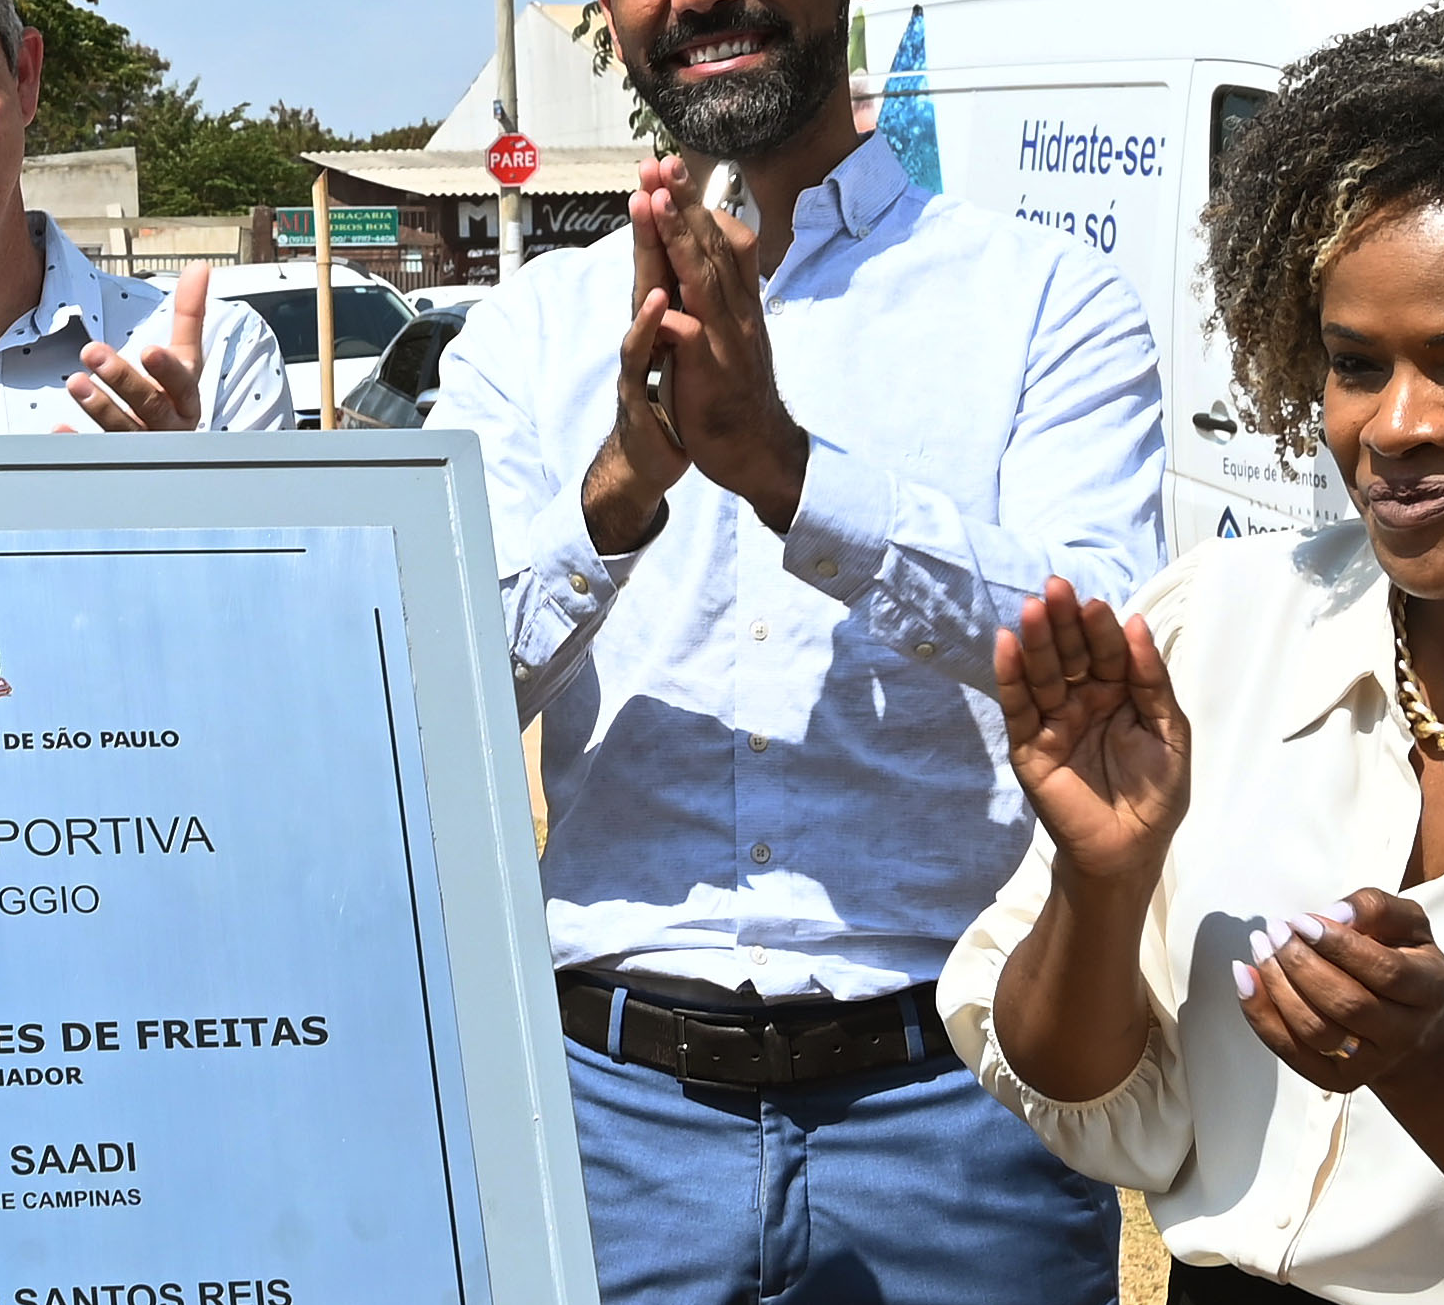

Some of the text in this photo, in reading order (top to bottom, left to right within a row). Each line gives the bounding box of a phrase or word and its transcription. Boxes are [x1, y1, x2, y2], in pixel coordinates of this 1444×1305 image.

[490, 151, 535, 168] PARE
[1019, 119, 1165, 176] Hidrate-se:
[280, 212, 310, 234] MJ
[329, 211, 393, 221] DRAÇARIA
[330, 223, 391, 231] DROS BOX
[1084, 199, 1117, 254] só
[1223, 457, 1328, 489] Equipe de eentos
[3, 732, 34, 751] DE
[42, 727, 92, 751] SÃO
[100, 730, 180, 750] PAULO
[61, 1021, 120, 1052] DE
[136, 1016, 329, 1050] FREITAS
[10, 1142, 136, 1176] SAADI
[22, 1188, 142, 1209] CAMPINAS
